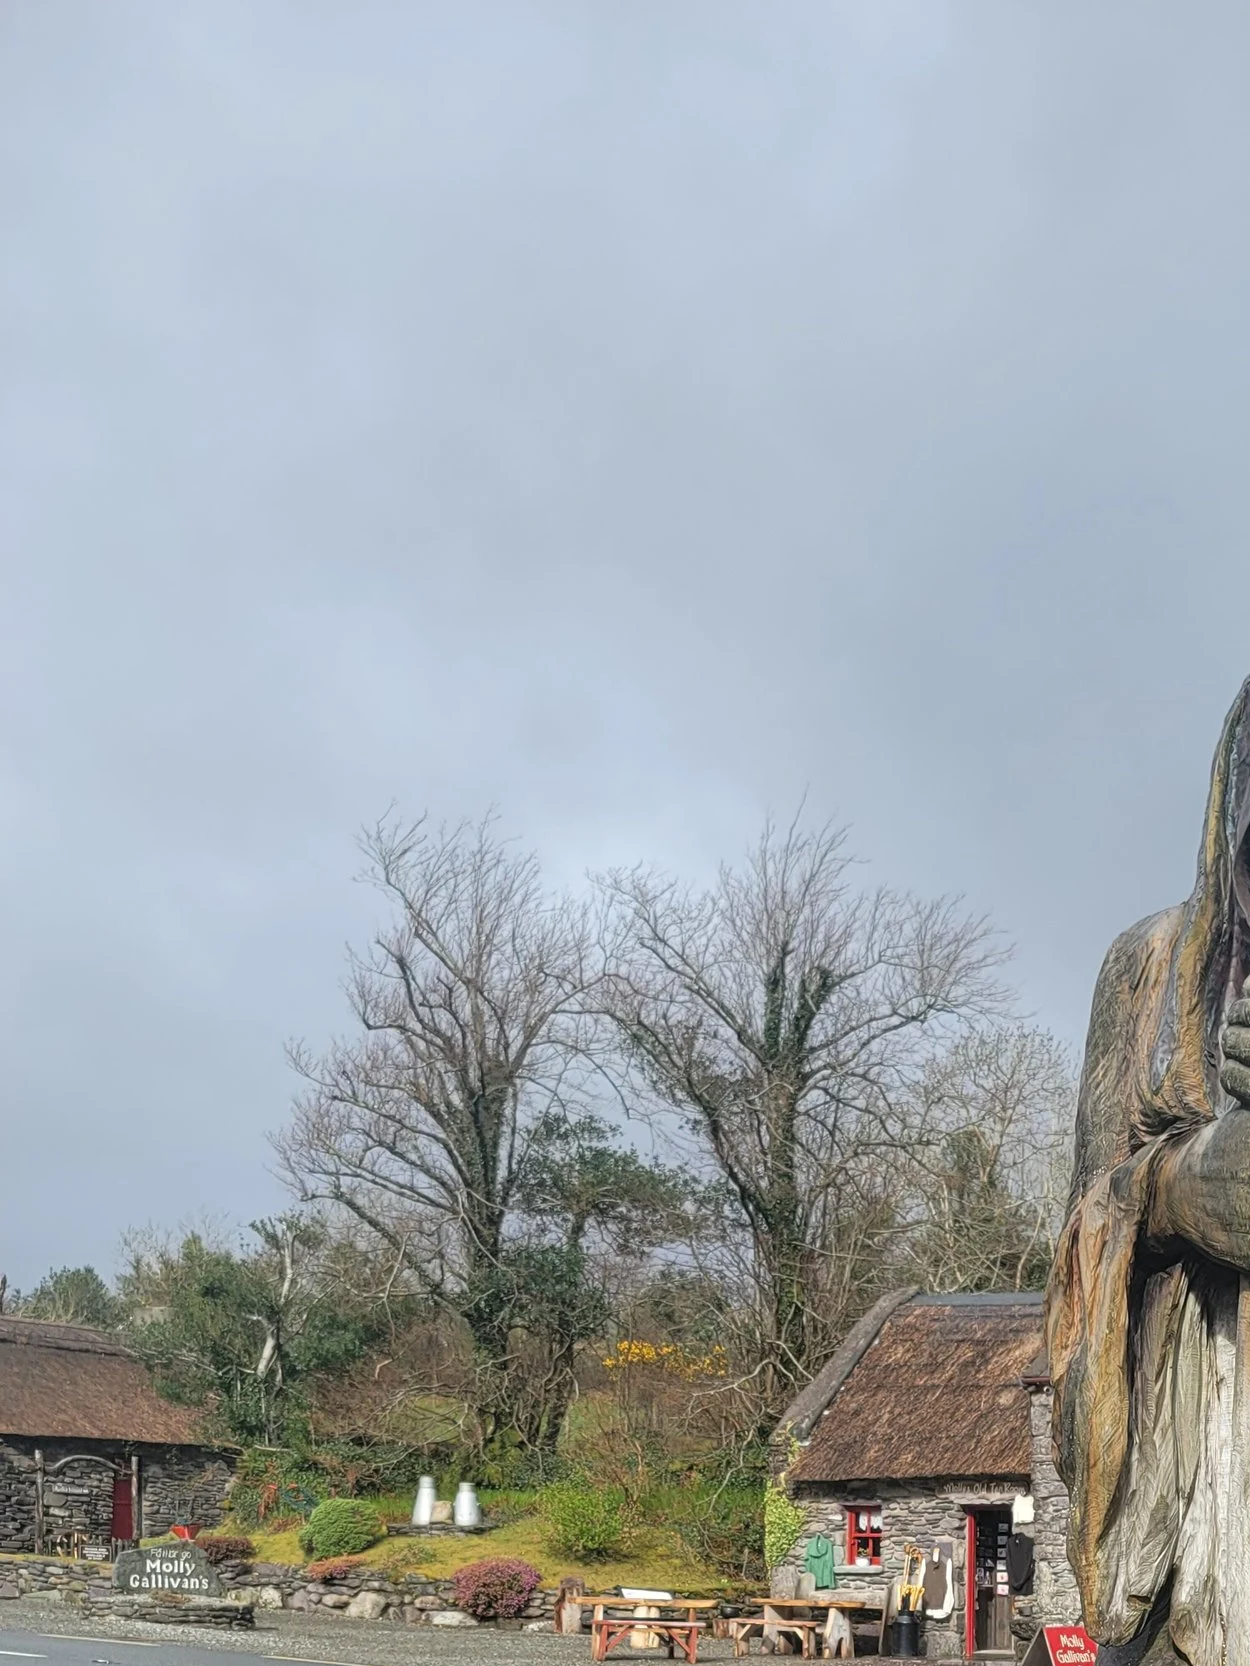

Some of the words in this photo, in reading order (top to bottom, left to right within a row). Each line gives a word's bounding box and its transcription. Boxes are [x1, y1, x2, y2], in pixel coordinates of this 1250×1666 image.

[973, 1482, 987, 1494] Old
[181, 1551, 192, 1561] go
[146, 1559, 196, 1576] Molly
[129, 1574, 209, 1590] Gallivan's
[1060, 1634, 1085, 1650] Molly
[1056, 1650, 1096, 1664] Gallivan's
